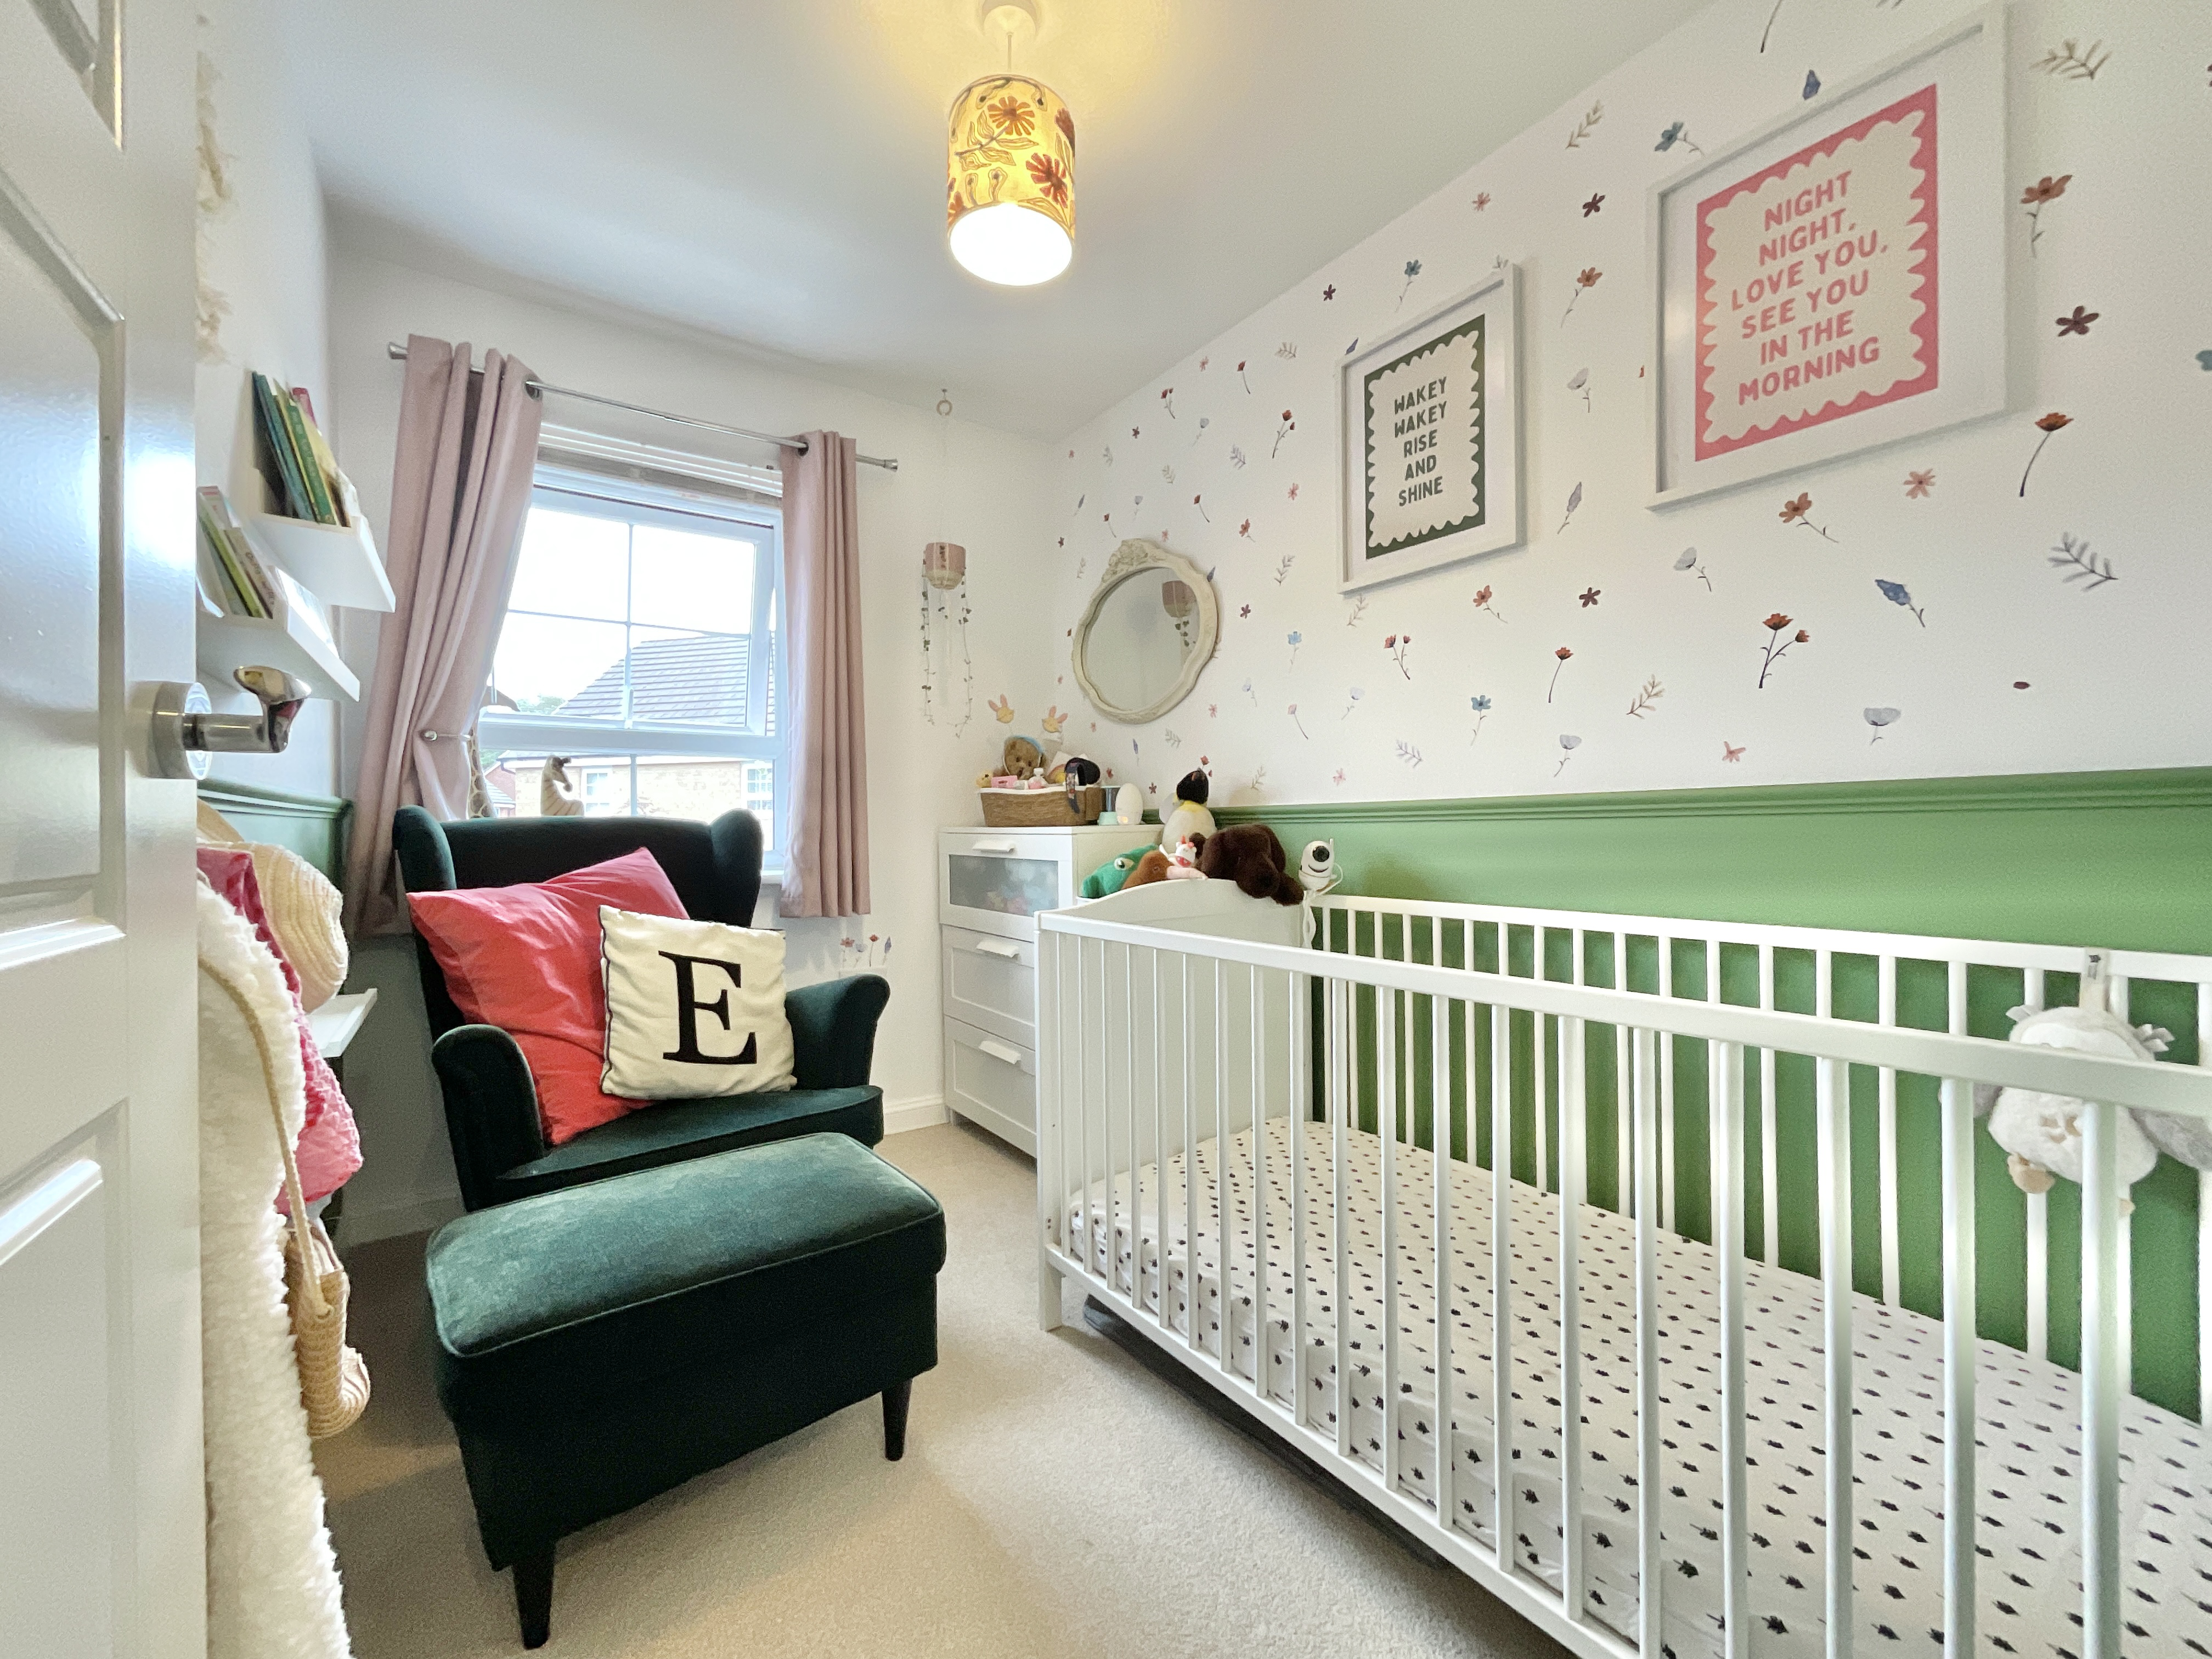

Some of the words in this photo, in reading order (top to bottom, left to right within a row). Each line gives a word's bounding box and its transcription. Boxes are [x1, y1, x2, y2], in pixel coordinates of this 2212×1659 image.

[1764, 171, 1852, 231] NIGHT
[1732, 261, 1803, 311] LOVE
[1742, 298, 1795, 339] SEE
[1806, 270, 1869, 313] YOU
[1761, 335, 1787, 366] IN
[1798, 310, 1854, 351] THE
[1395, 376, 1447, 415] WAKEY
[1739, 337, 1880, 405] MORNING
[1395, 401, 1447, 438] WAKEY
[1404, 429, 1438, 458] RISE
[1399, 476, 1443, 507] SHINE
[1405, 455, 1437, 481] AND
[658, 951, 757, 1065] E
